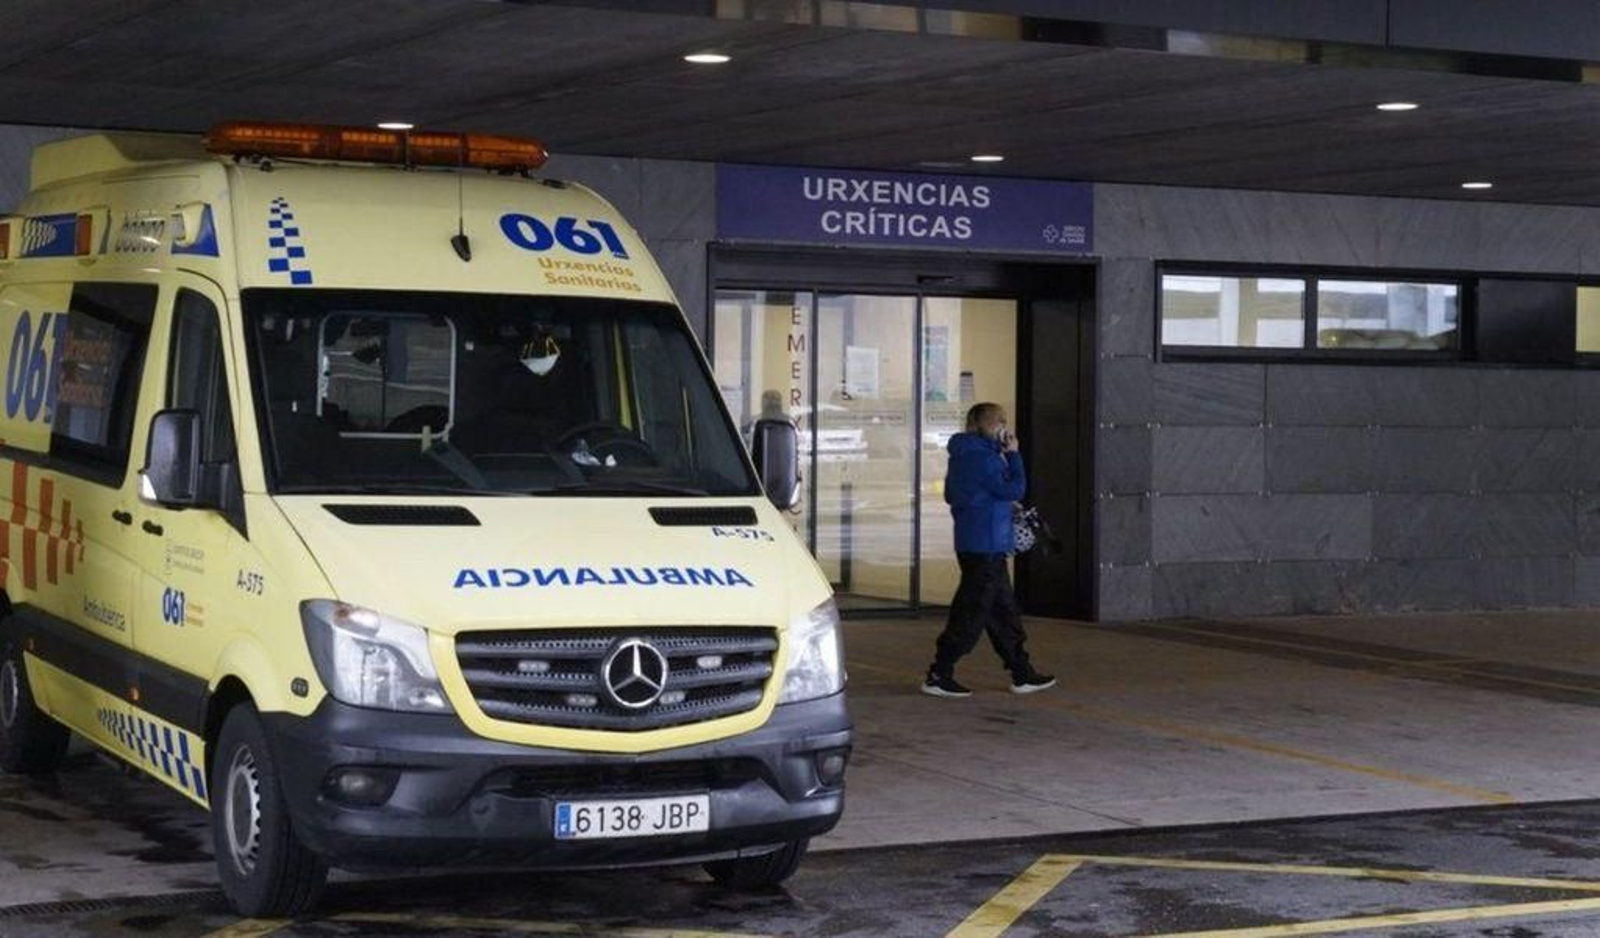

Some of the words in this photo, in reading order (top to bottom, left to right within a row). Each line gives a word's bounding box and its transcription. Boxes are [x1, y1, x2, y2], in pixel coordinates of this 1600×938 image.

[802, 177, 991, 209] URXENCIAS
[500, 213, 629, 259] 061
[820, 206, 973, 239] CRÍTICAS
[538, 257, 634, 277] Urxencias
[544, 273, 642, 292] Sanitarias
[712, 526, 775, 542] A-575
[237, 568, 263, 596] A-575
[163, 586, 187, 628] 061
[576, 805, 642, 834] 6138
[653, 801, 700, 830] JBP
